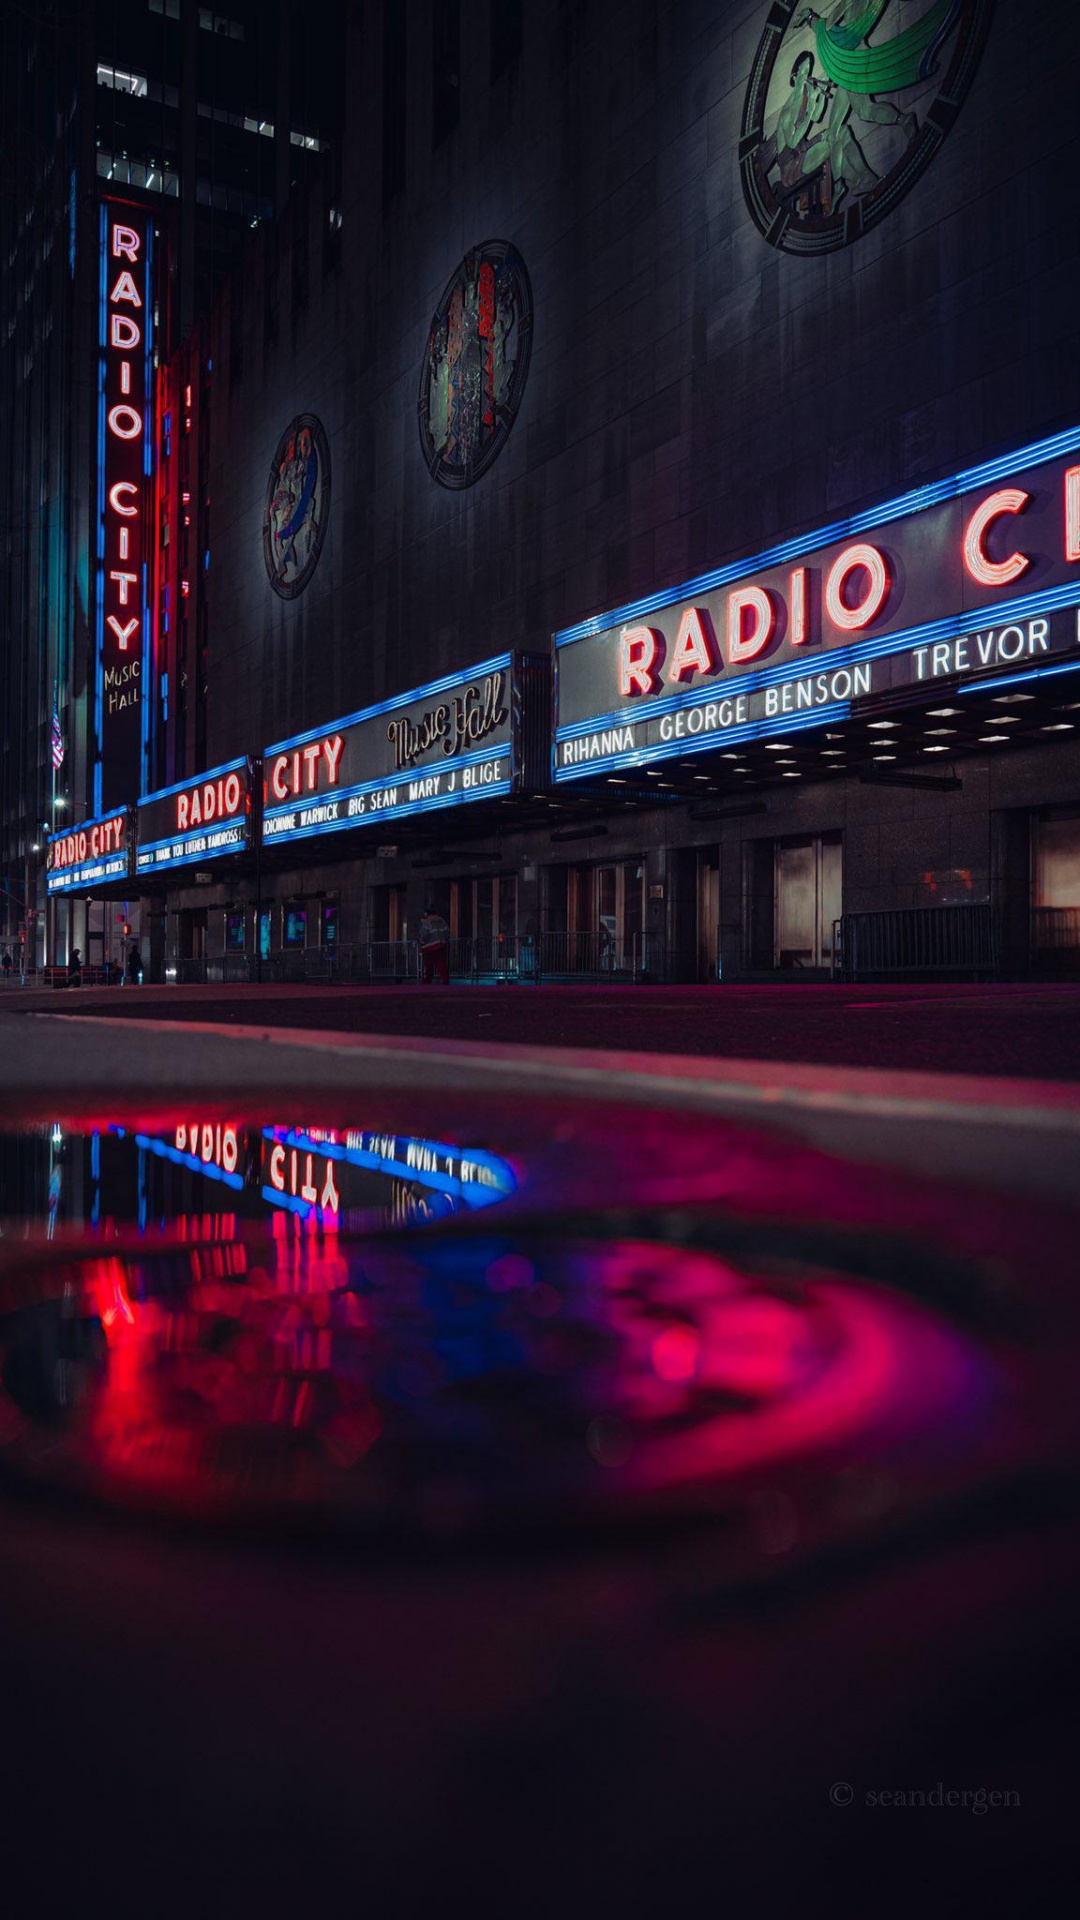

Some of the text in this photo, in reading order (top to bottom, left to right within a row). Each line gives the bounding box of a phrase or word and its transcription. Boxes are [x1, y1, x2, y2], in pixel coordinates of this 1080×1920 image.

[106, 223, 143, 651] RADIO CITY
[616, 542, 892, 697] RADIO
[272, 672, 503, 799] CITY Music Hall
[562, 726, 635, 765] RIHANNA
[659, 695, 748, 741] GEORGE
[764, 662, 872, 717] BENSON
[912, 618, 1051, 680] TREVOR
[54, 816, 123, 868] RADIO CITY
[176, 773, 241, 830] RADIO
[300, 802, 339, 827] WARWICK
[348, 797, 365, 817] BIG
[370, 787, 398, 811] SEAN
[409, 775, 441, 801] MARY
[447, 771, 456, 792] J
[462, 760, 502, 788] BLIGE
[173, 842, 184, 857] YOU
